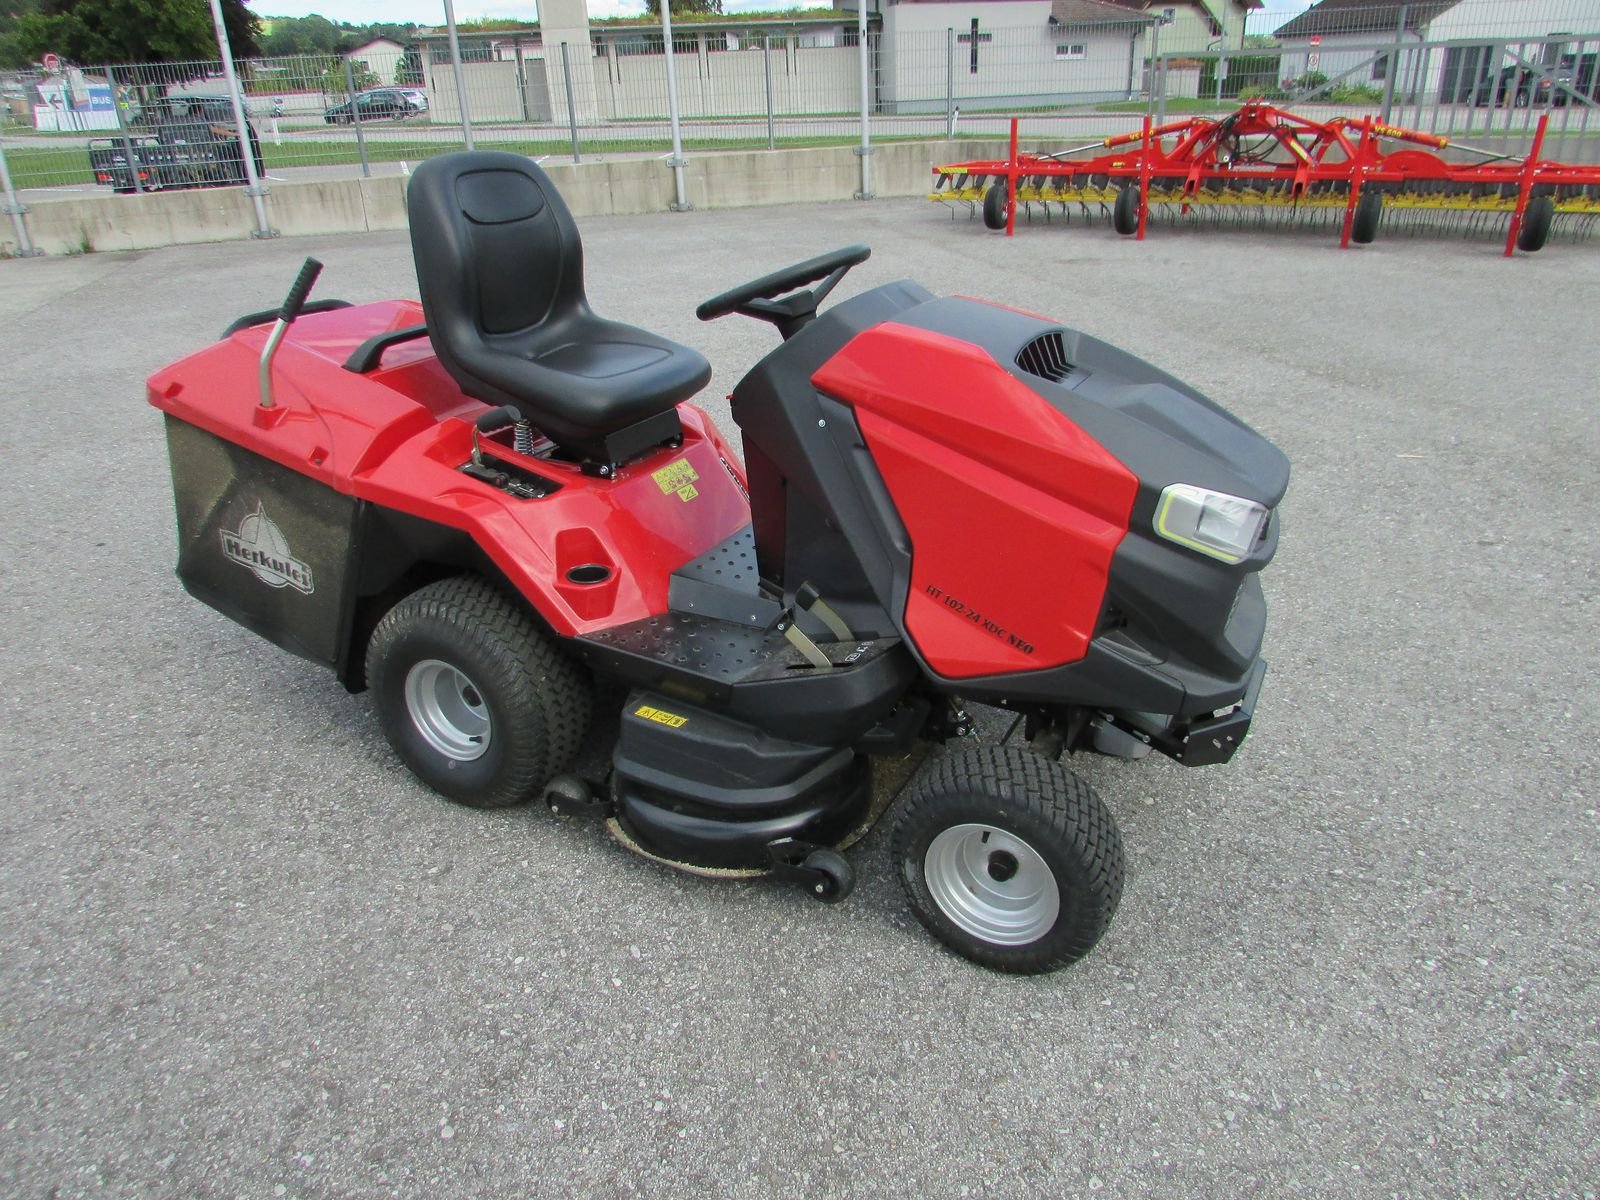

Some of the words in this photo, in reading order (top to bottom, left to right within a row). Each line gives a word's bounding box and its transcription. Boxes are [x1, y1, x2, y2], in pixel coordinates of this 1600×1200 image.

[926, 585, 943, 598] HT
[944, 595, 981, 623] 102-24
[981, 619, 1007, 638] XDC
[1007, 633, 1035, 654] NEO
